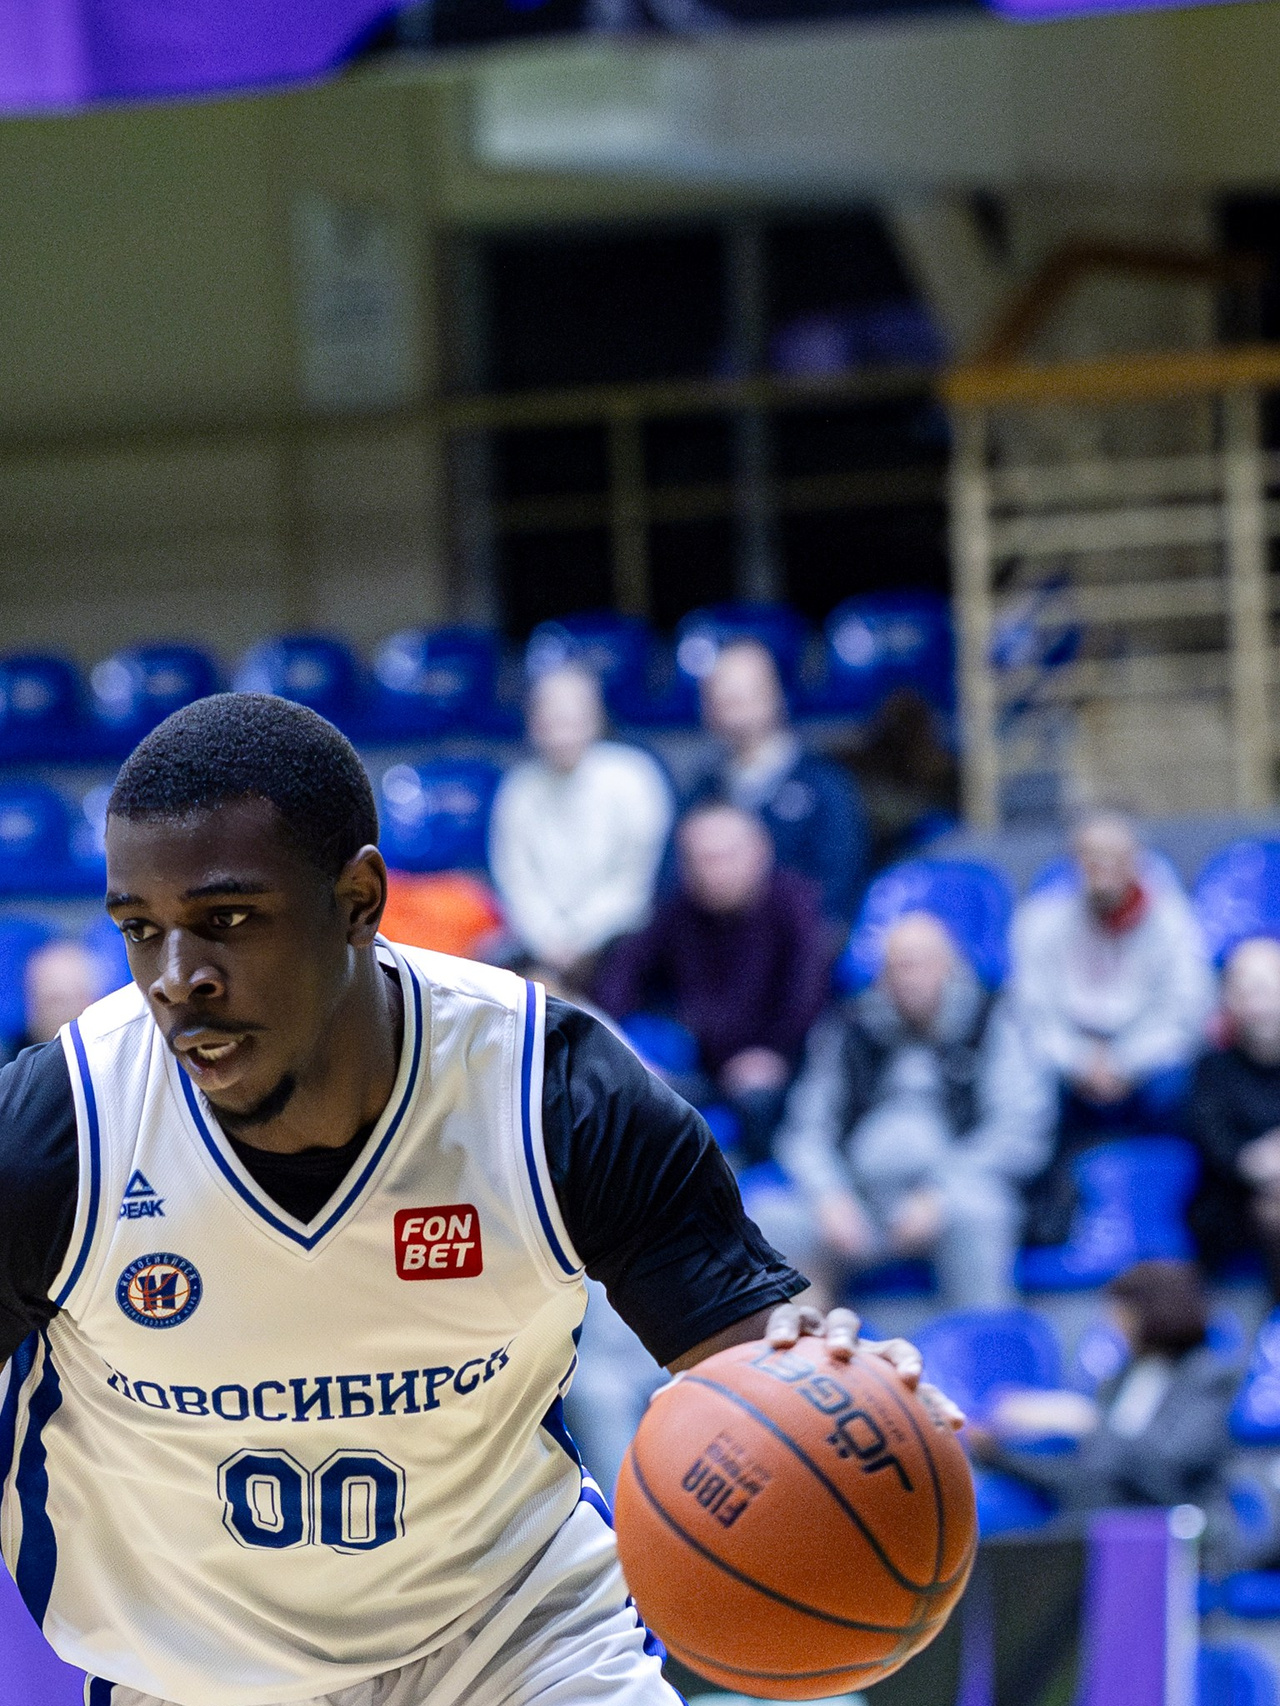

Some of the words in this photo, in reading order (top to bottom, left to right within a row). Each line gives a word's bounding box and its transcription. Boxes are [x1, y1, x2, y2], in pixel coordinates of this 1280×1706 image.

[401, 1213, 472, 1242] FON
[403, 1242, 475, 1270] BET
[217, 1448, 407, 1555] 00
[681, 1456, 750, 1529] FIBA
